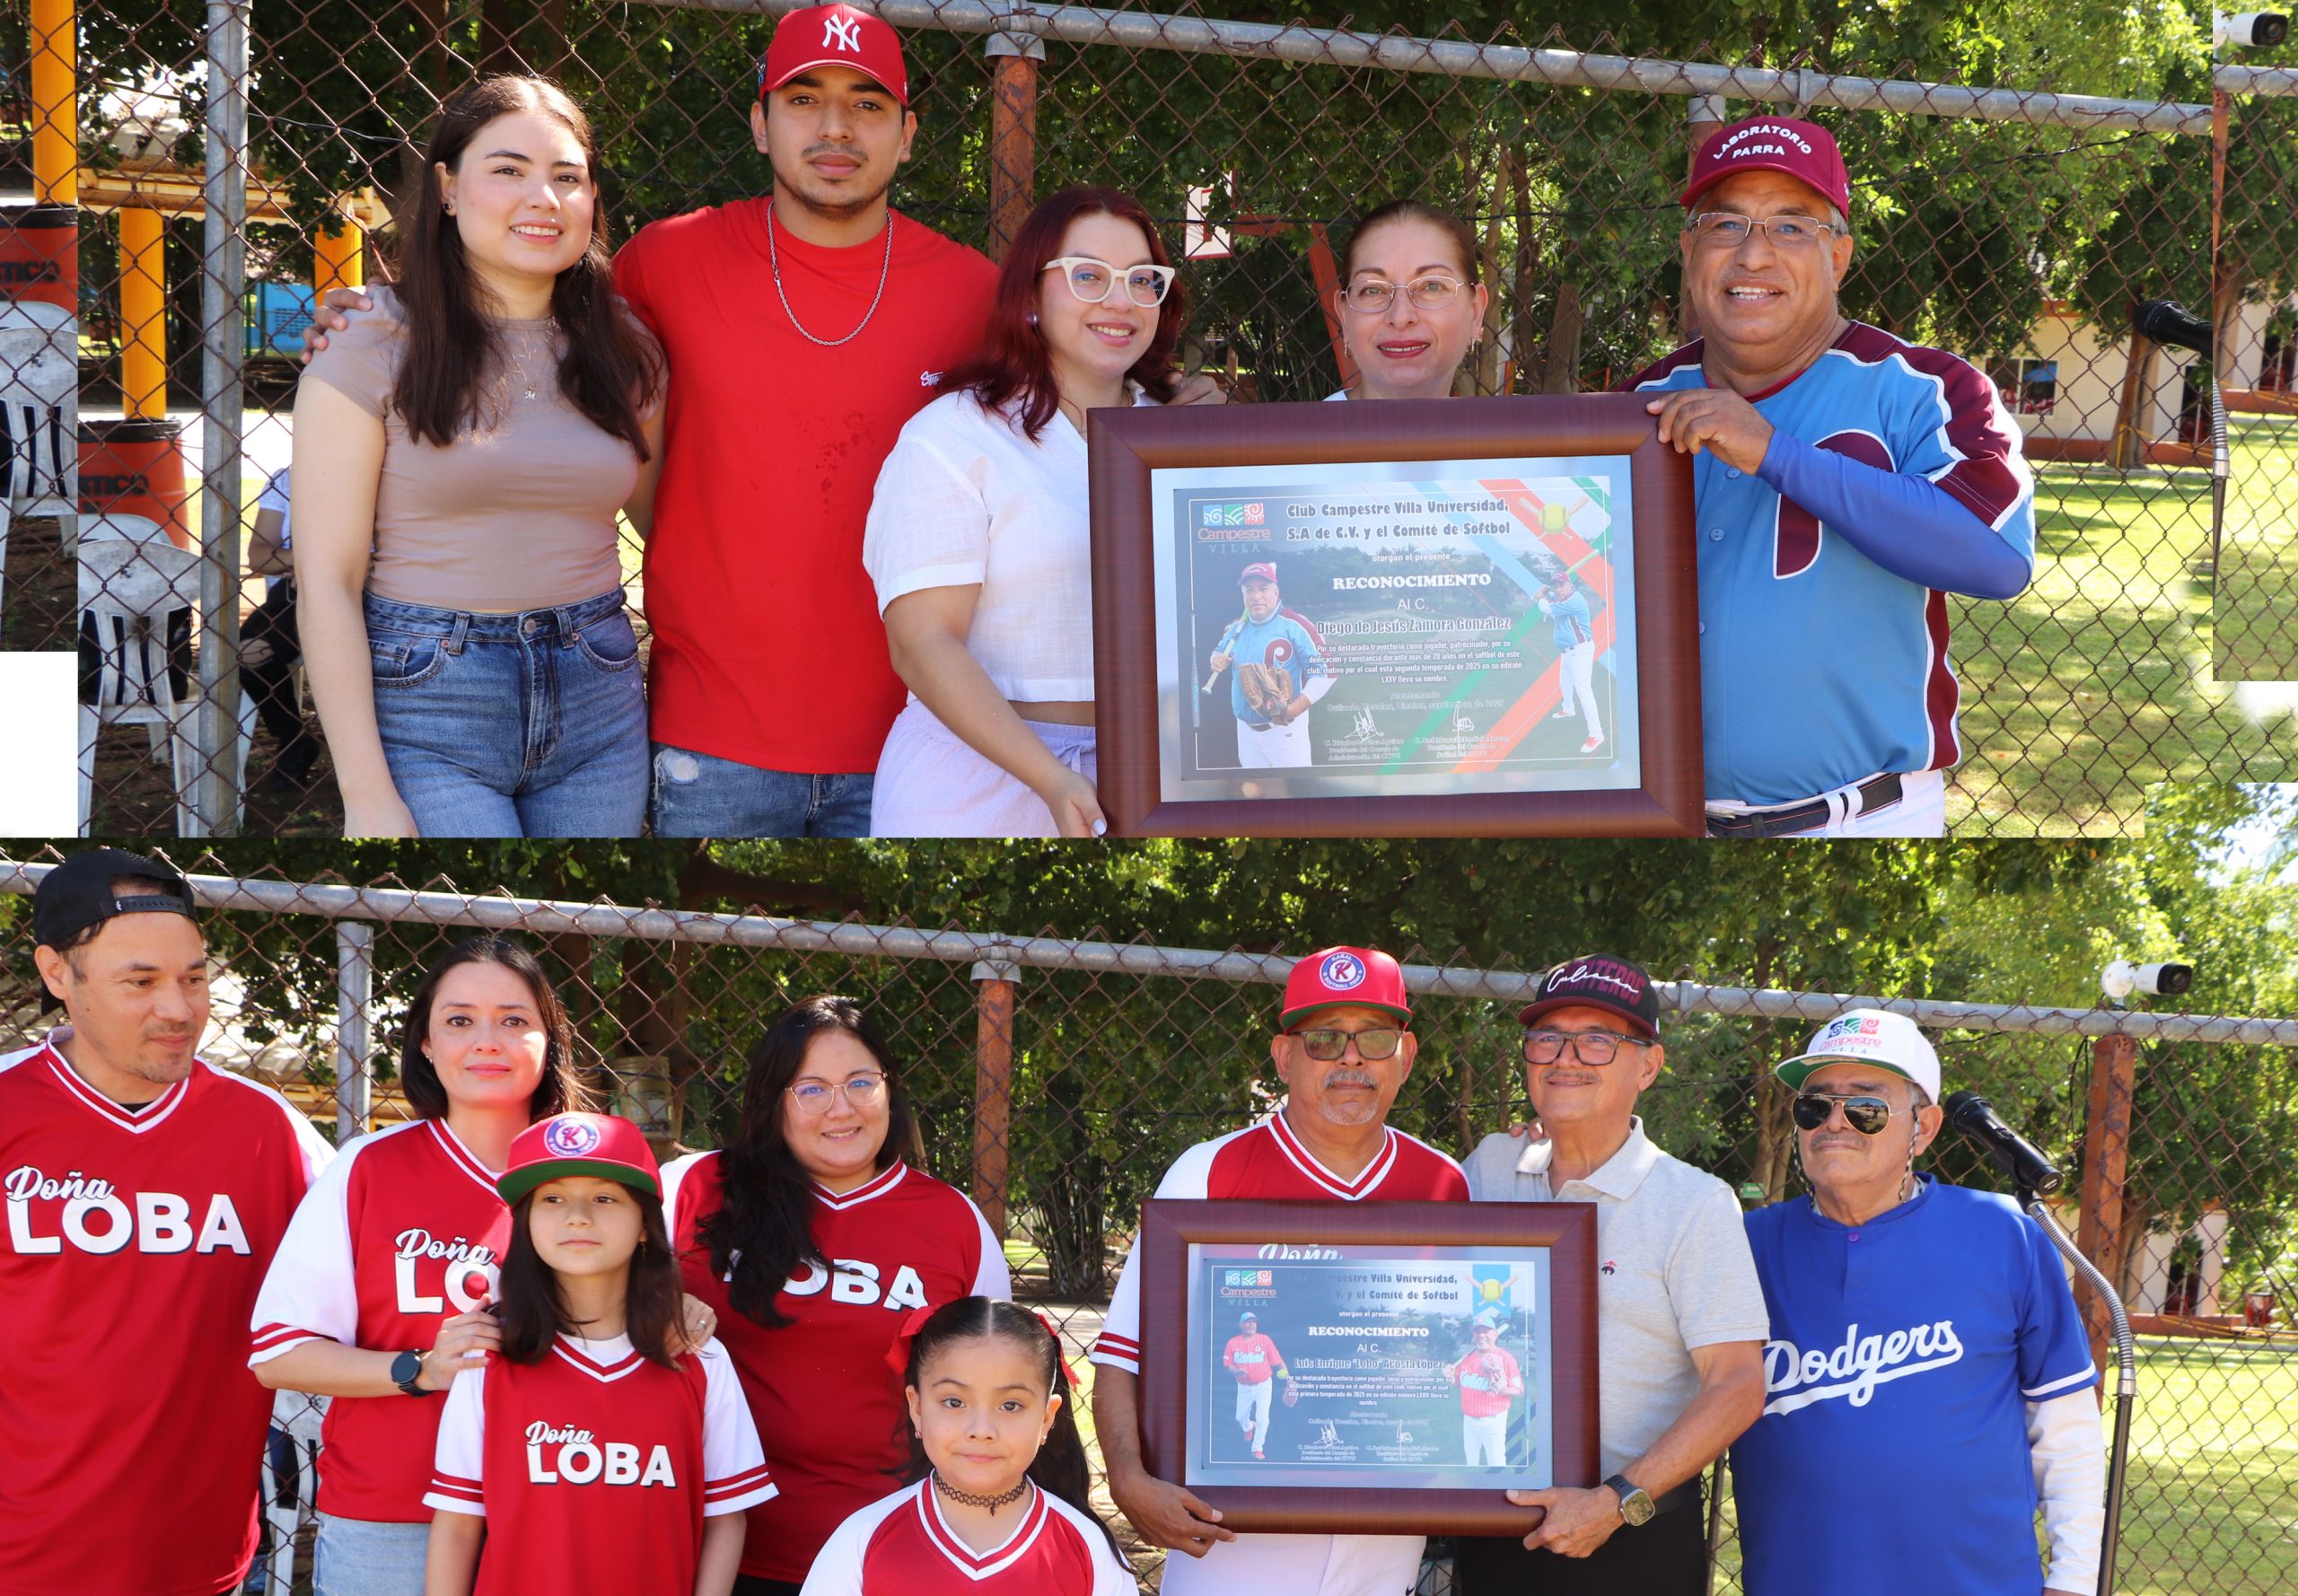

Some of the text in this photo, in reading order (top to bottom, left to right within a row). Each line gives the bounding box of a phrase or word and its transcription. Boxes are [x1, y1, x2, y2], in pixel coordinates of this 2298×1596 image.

[1713, 124, 1812, 160] LABORATORIO
[1732, 145, 1785, 159] PARRA
[1287, 499, 1509, 517] Club Campestre Villa Universidad,
[1197, 528, 1271, 540] Campestre
[1287, 522, 1511, 540] S.A de C.V. y el Comité de Softbol
[1208, 544, 1261, 553] VILLA
[1373, 552, 1451, 563] otorgan el presente
[1333, 574, 1492, 590] RECONOCIMIENTO
[1397, 598, 1429, 610] Al C.
[1317, 616, 1511, 636] Diego de Jesús Zamora González
[1335, 961, 1353, 979] K
[4, 1165, 115, 1203] Doña
[6, 1191, 253, 1255] LOBA
[395, 1228, 496, 1266] Doña
[723, 1248, 929, 1312] OBA
[1371, 1273, 1392, 1284] Villa
[1396, 1273, 1458, 1284] Universidad,
[1221, 1287, 1276, 1296] Campestre
[1356, 1290, 1365, 1300] el
[1369, 1290, 1403, 1300] Comité
[1408, 1291, 1419, 1300] de
[1423, 1290, 1458, 1301] Softbol
[1228, 1299, 1268, 1307] VILLA
[1309, 1326, 1430, 1337] RECONOCIMIENTO
[1357, 1344, 1381, 1353] Al C.
[1761, 1320, 1964, 1416] Dodgers
[525, 1420, 594, 1446] Doña
[526, 1442, 677, 1488] LOBA
